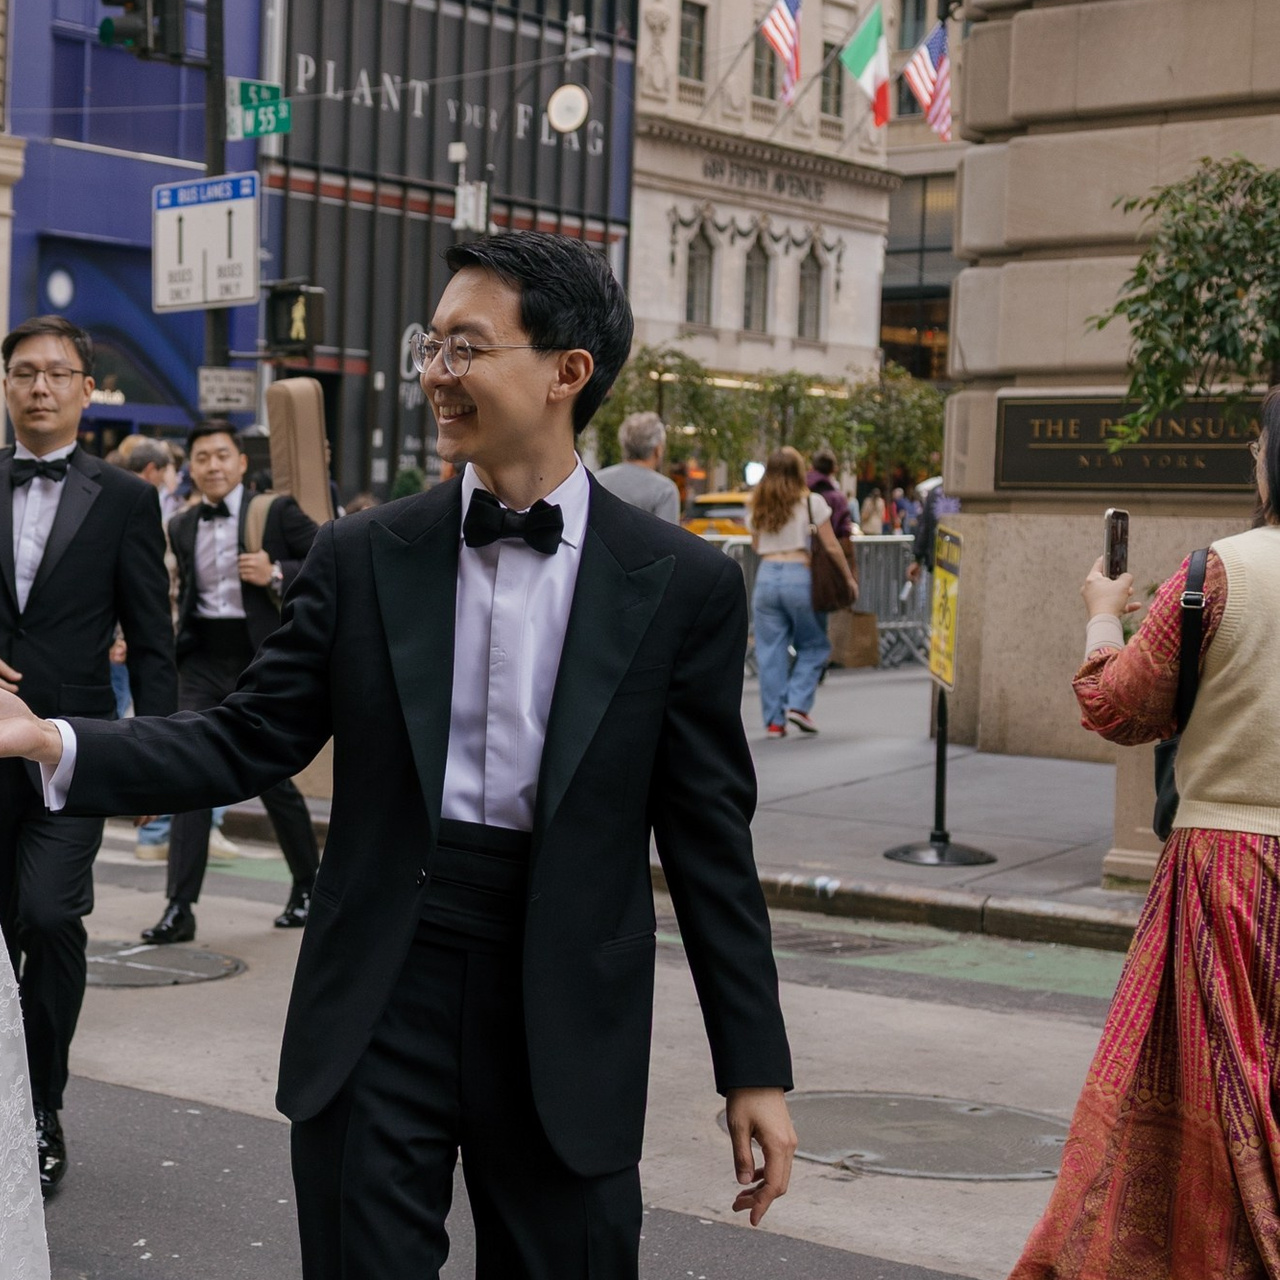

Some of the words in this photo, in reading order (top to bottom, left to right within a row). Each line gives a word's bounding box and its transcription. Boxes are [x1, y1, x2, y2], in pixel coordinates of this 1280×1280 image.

[296, 53, 430, 118] PLANT
[258, 106, 277, 132] 55
[1030, 418, 1080, 439] THE
[1080, 454, 1124, 468] NEW
[1143, 454, 1206, 469] YORK
